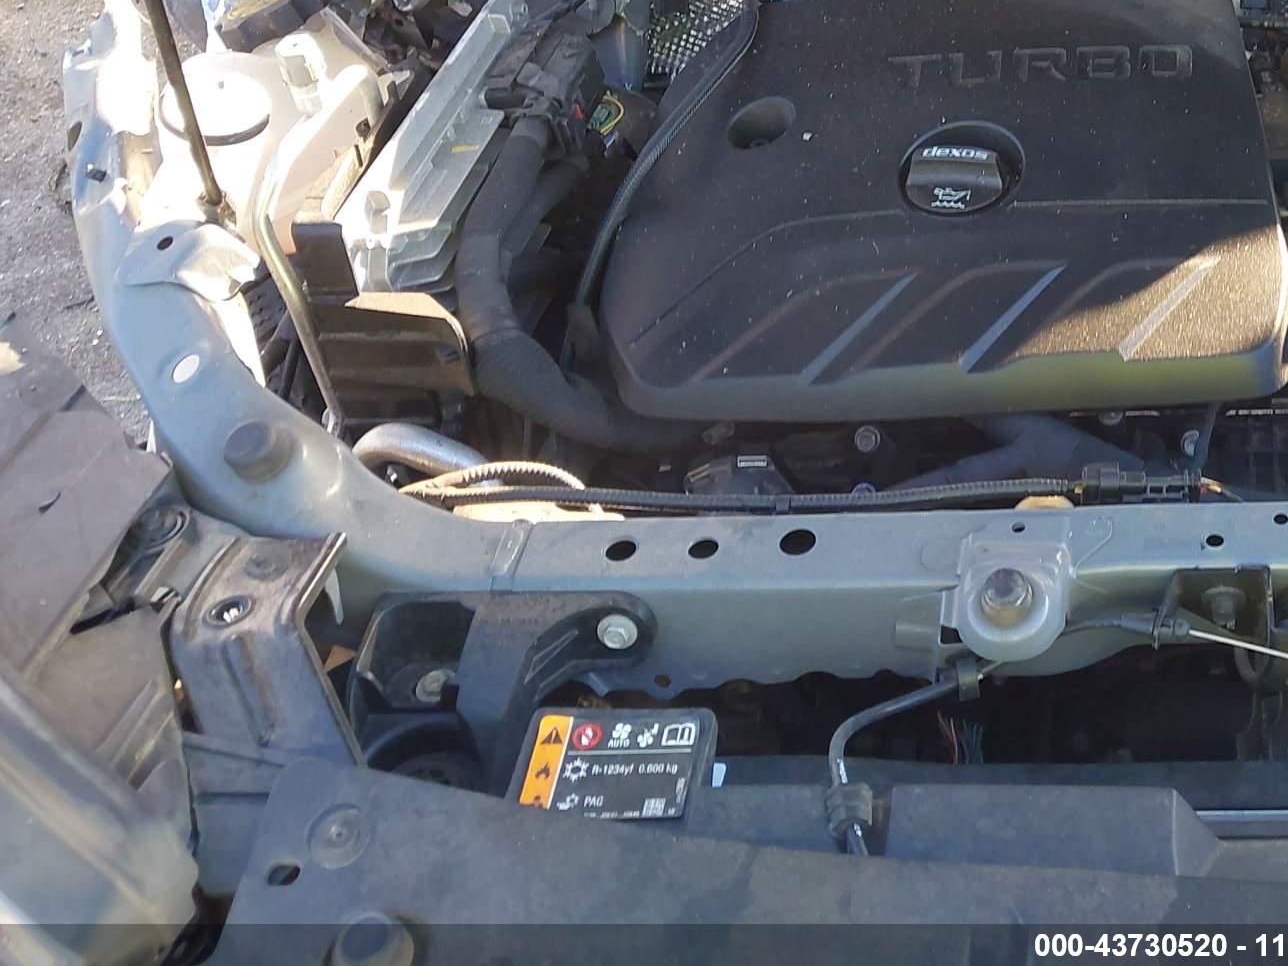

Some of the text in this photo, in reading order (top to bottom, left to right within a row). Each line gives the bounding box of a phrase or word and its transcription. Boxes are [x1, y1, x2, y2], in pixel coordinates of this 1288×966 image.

[887, 44, 1194, 89] TURBO
[921, 144, 990, 161] dexos
[607, 738, 630, 749] AUTO
[591, 762, 679, 776] R-1234yf 0.600 kg
[583, 795, 604, 808] PAG
